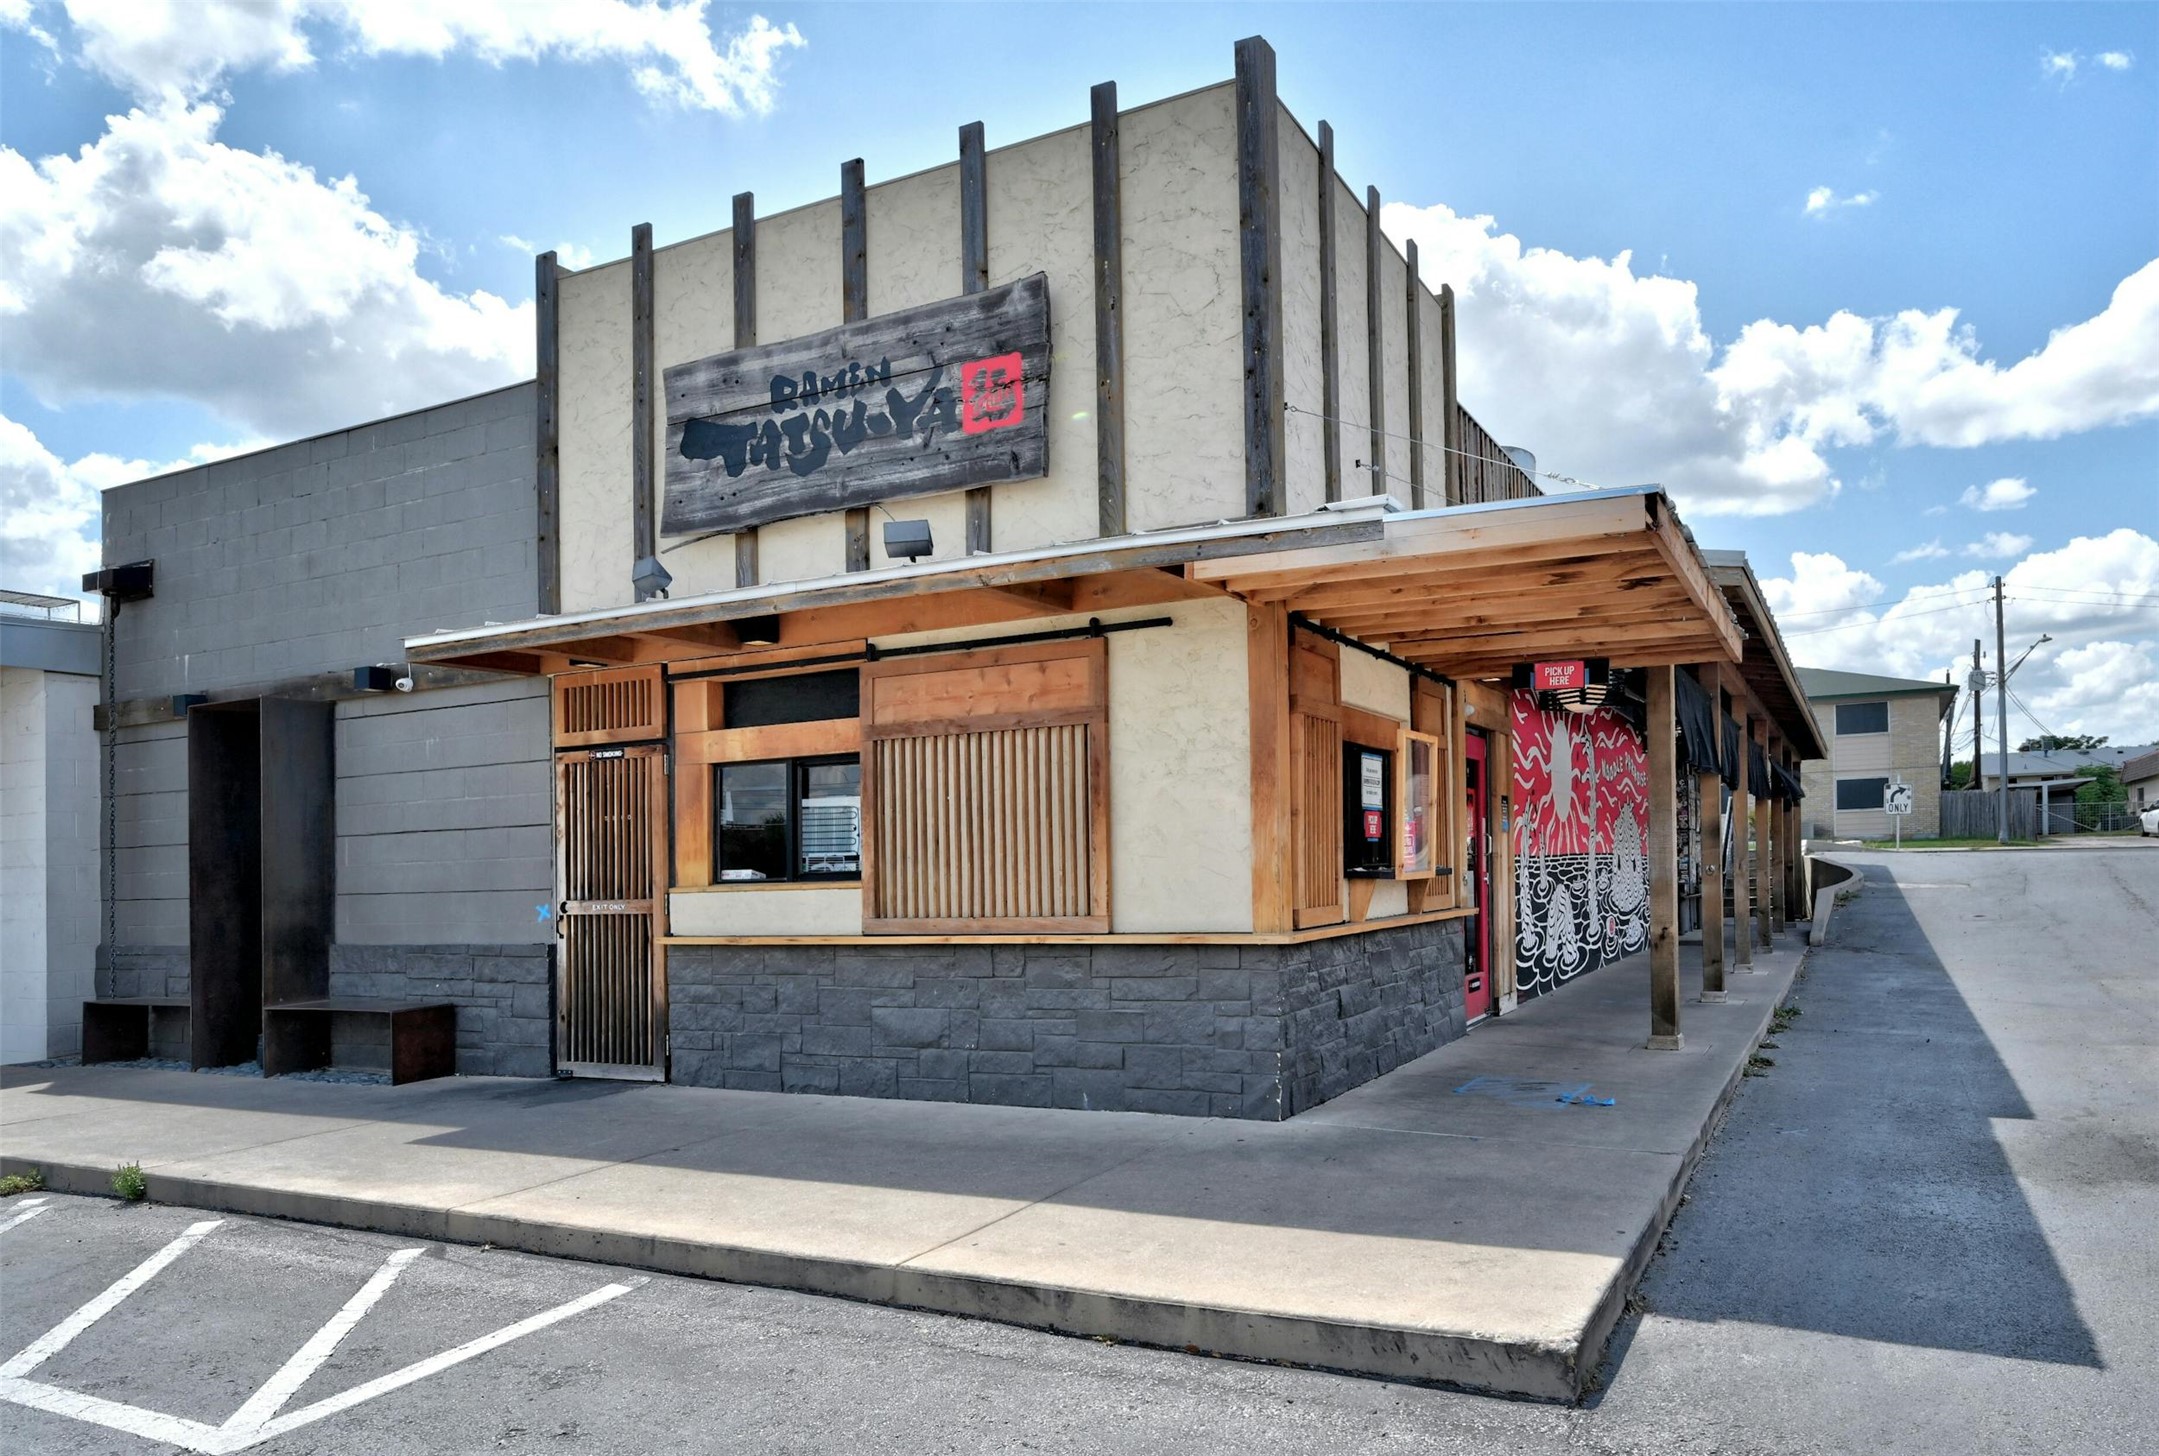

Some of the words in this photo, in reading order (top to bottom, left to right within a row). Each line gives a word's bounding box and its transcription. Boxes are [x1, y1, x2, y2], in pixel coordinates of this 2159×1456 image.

[770, 356, 891, 414] RAMEN
[1545, 666, 1563, 677] PICK
[1564, 665, 1575, 676] UP
[1549, 676, 1570, 686] HERE
[1888, 803, 1909, 813] ONLY
[609, 903, 626, 911] ONLY
